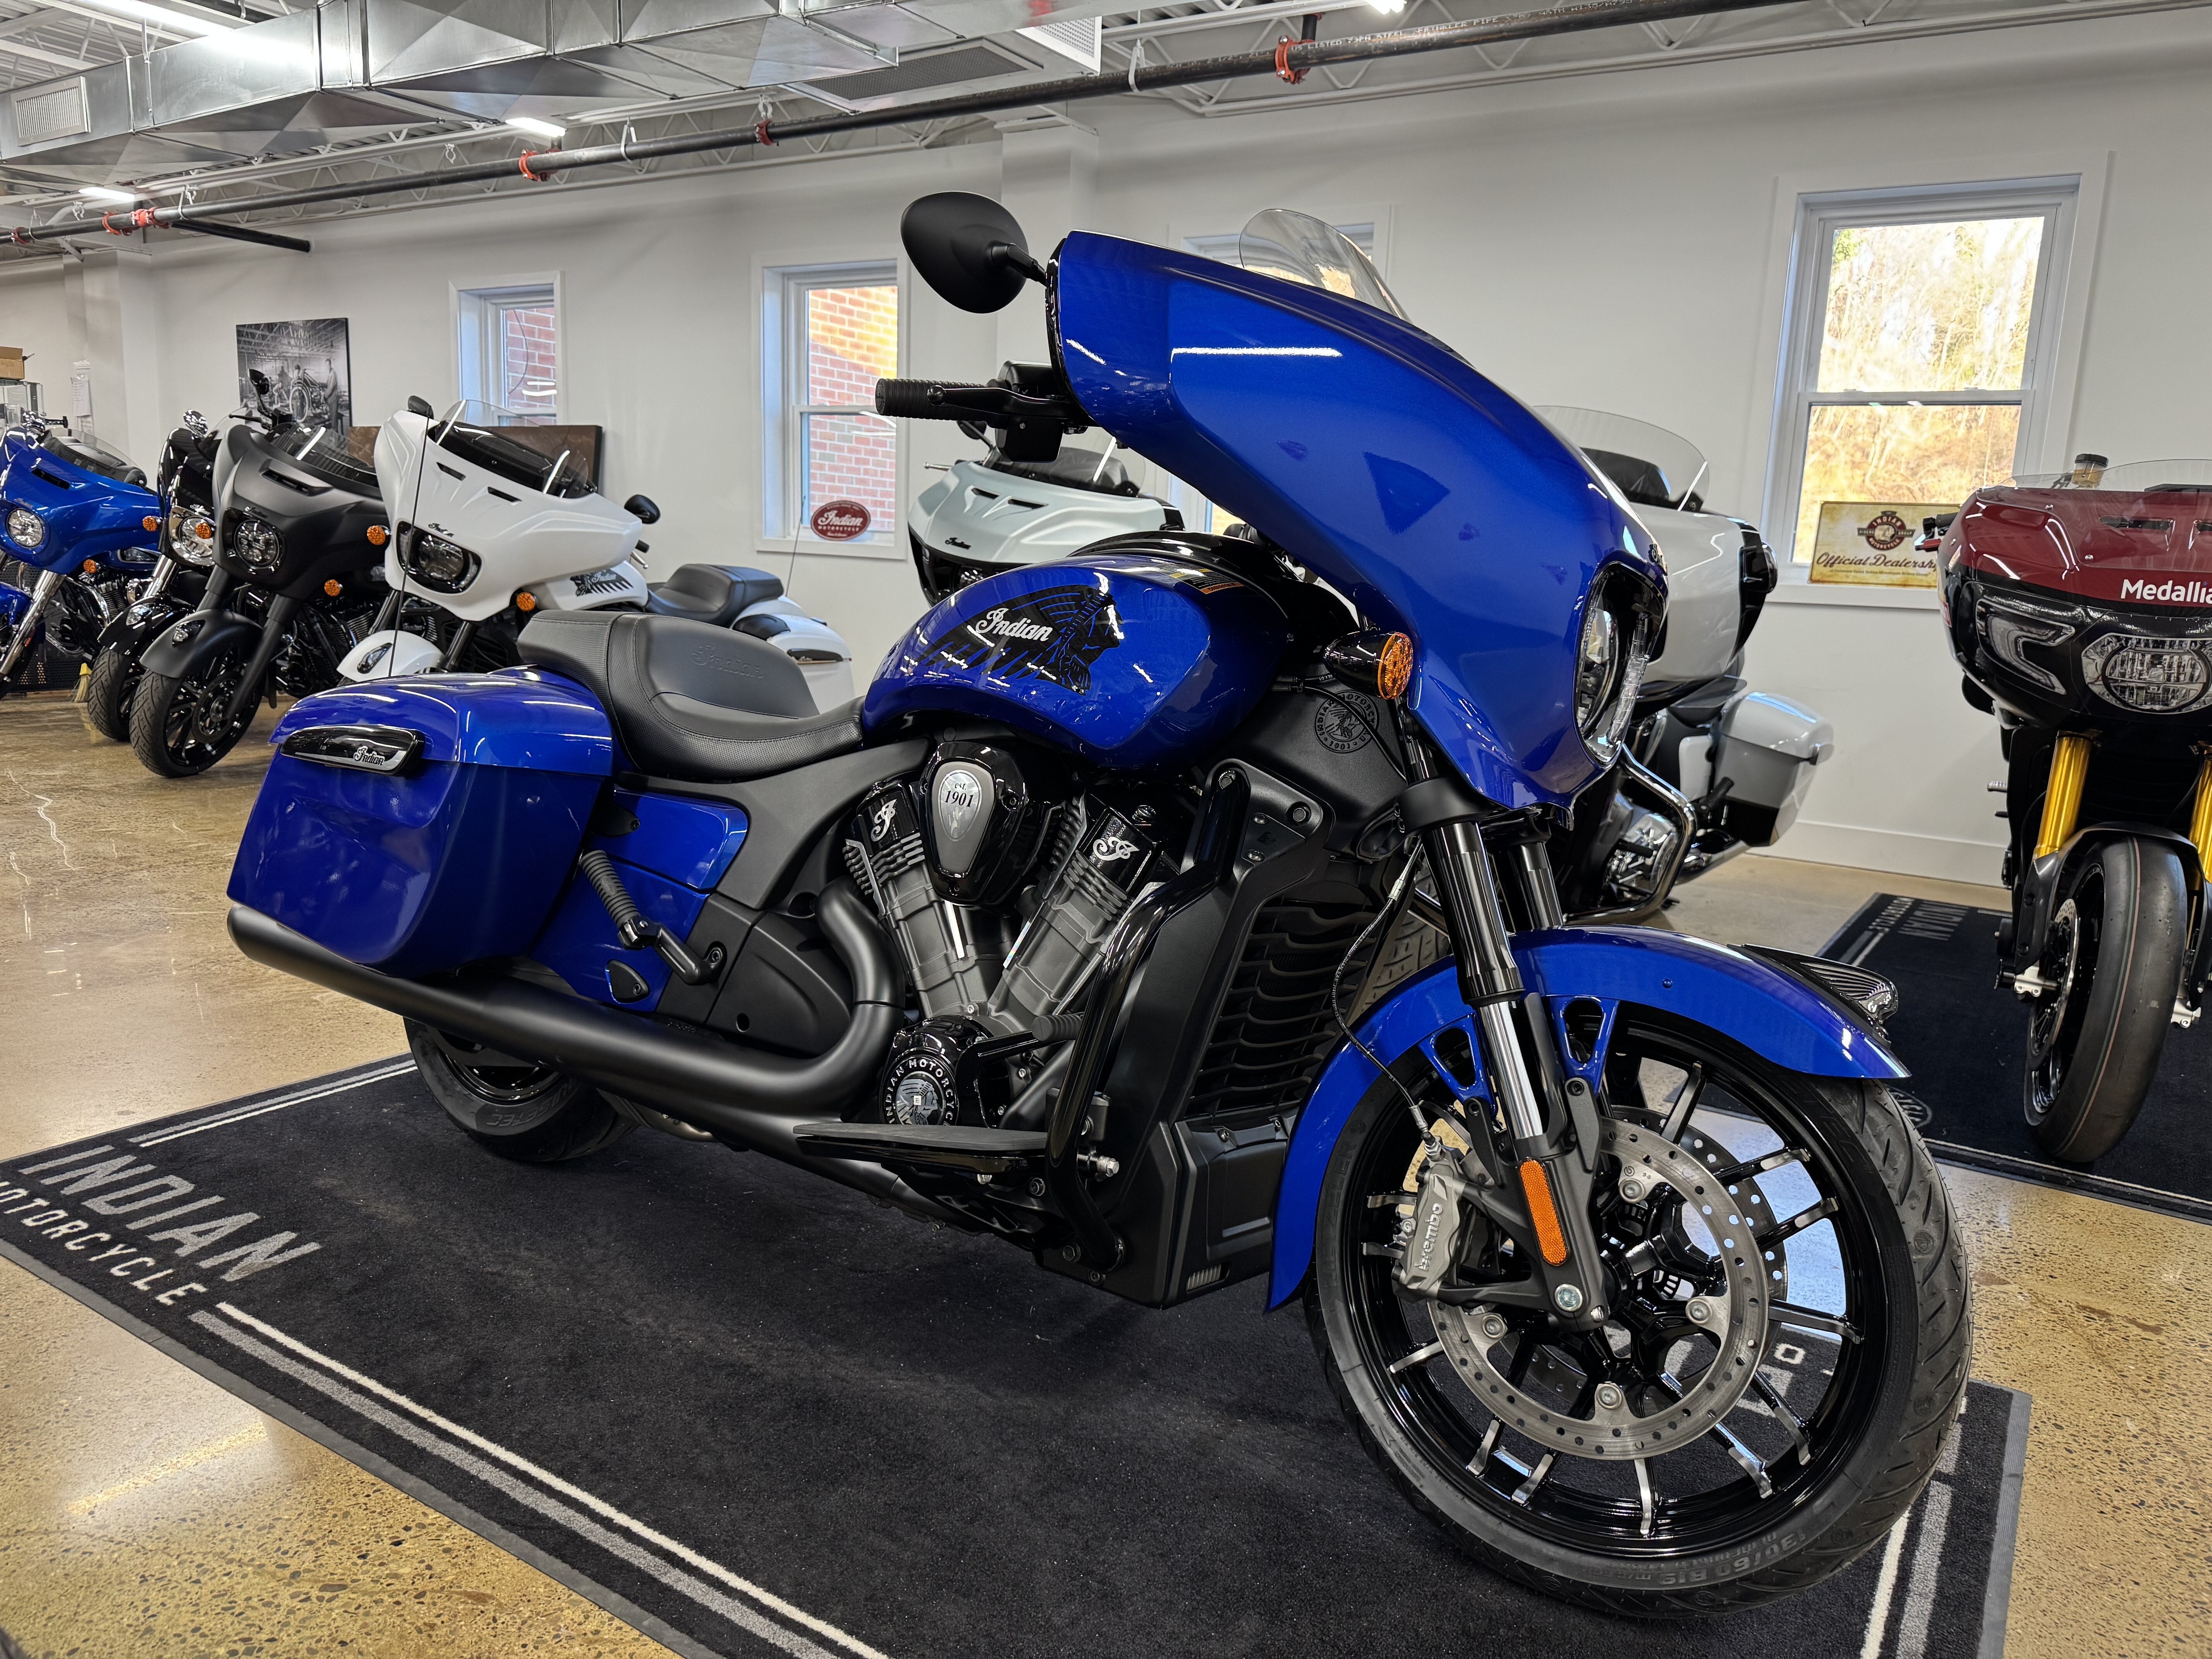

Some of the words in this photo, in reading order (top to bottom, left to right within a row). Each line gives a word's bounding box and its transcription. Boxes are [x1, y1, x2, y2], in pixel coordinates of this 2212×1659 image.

[1308, 39, 1342, 49] LISTED
[1473, 16, 1499, 26] PIPE
[817, 510, 864, 526] Indian
[1872, 516, 1902, 527] INDIAN
[1816, 551, 1870, 567] Official
[591, 572, 617, 583] Indian
[975, 608, 1053, 642] Indian
[354, 746, 385, 766] Indian
[955, 782, 967, 790] est.
[945, 790, 974, 807] 1901
[886, 1066, 904, 1124] INDIAN
[909, 1058, 954, 1126] MOTORCYC
[19, 1145, 322, 1282] INDIAN
[1414, 1203, 1443, 1271] brembo
[1716, 1528, 1806, 1577] 130/60
